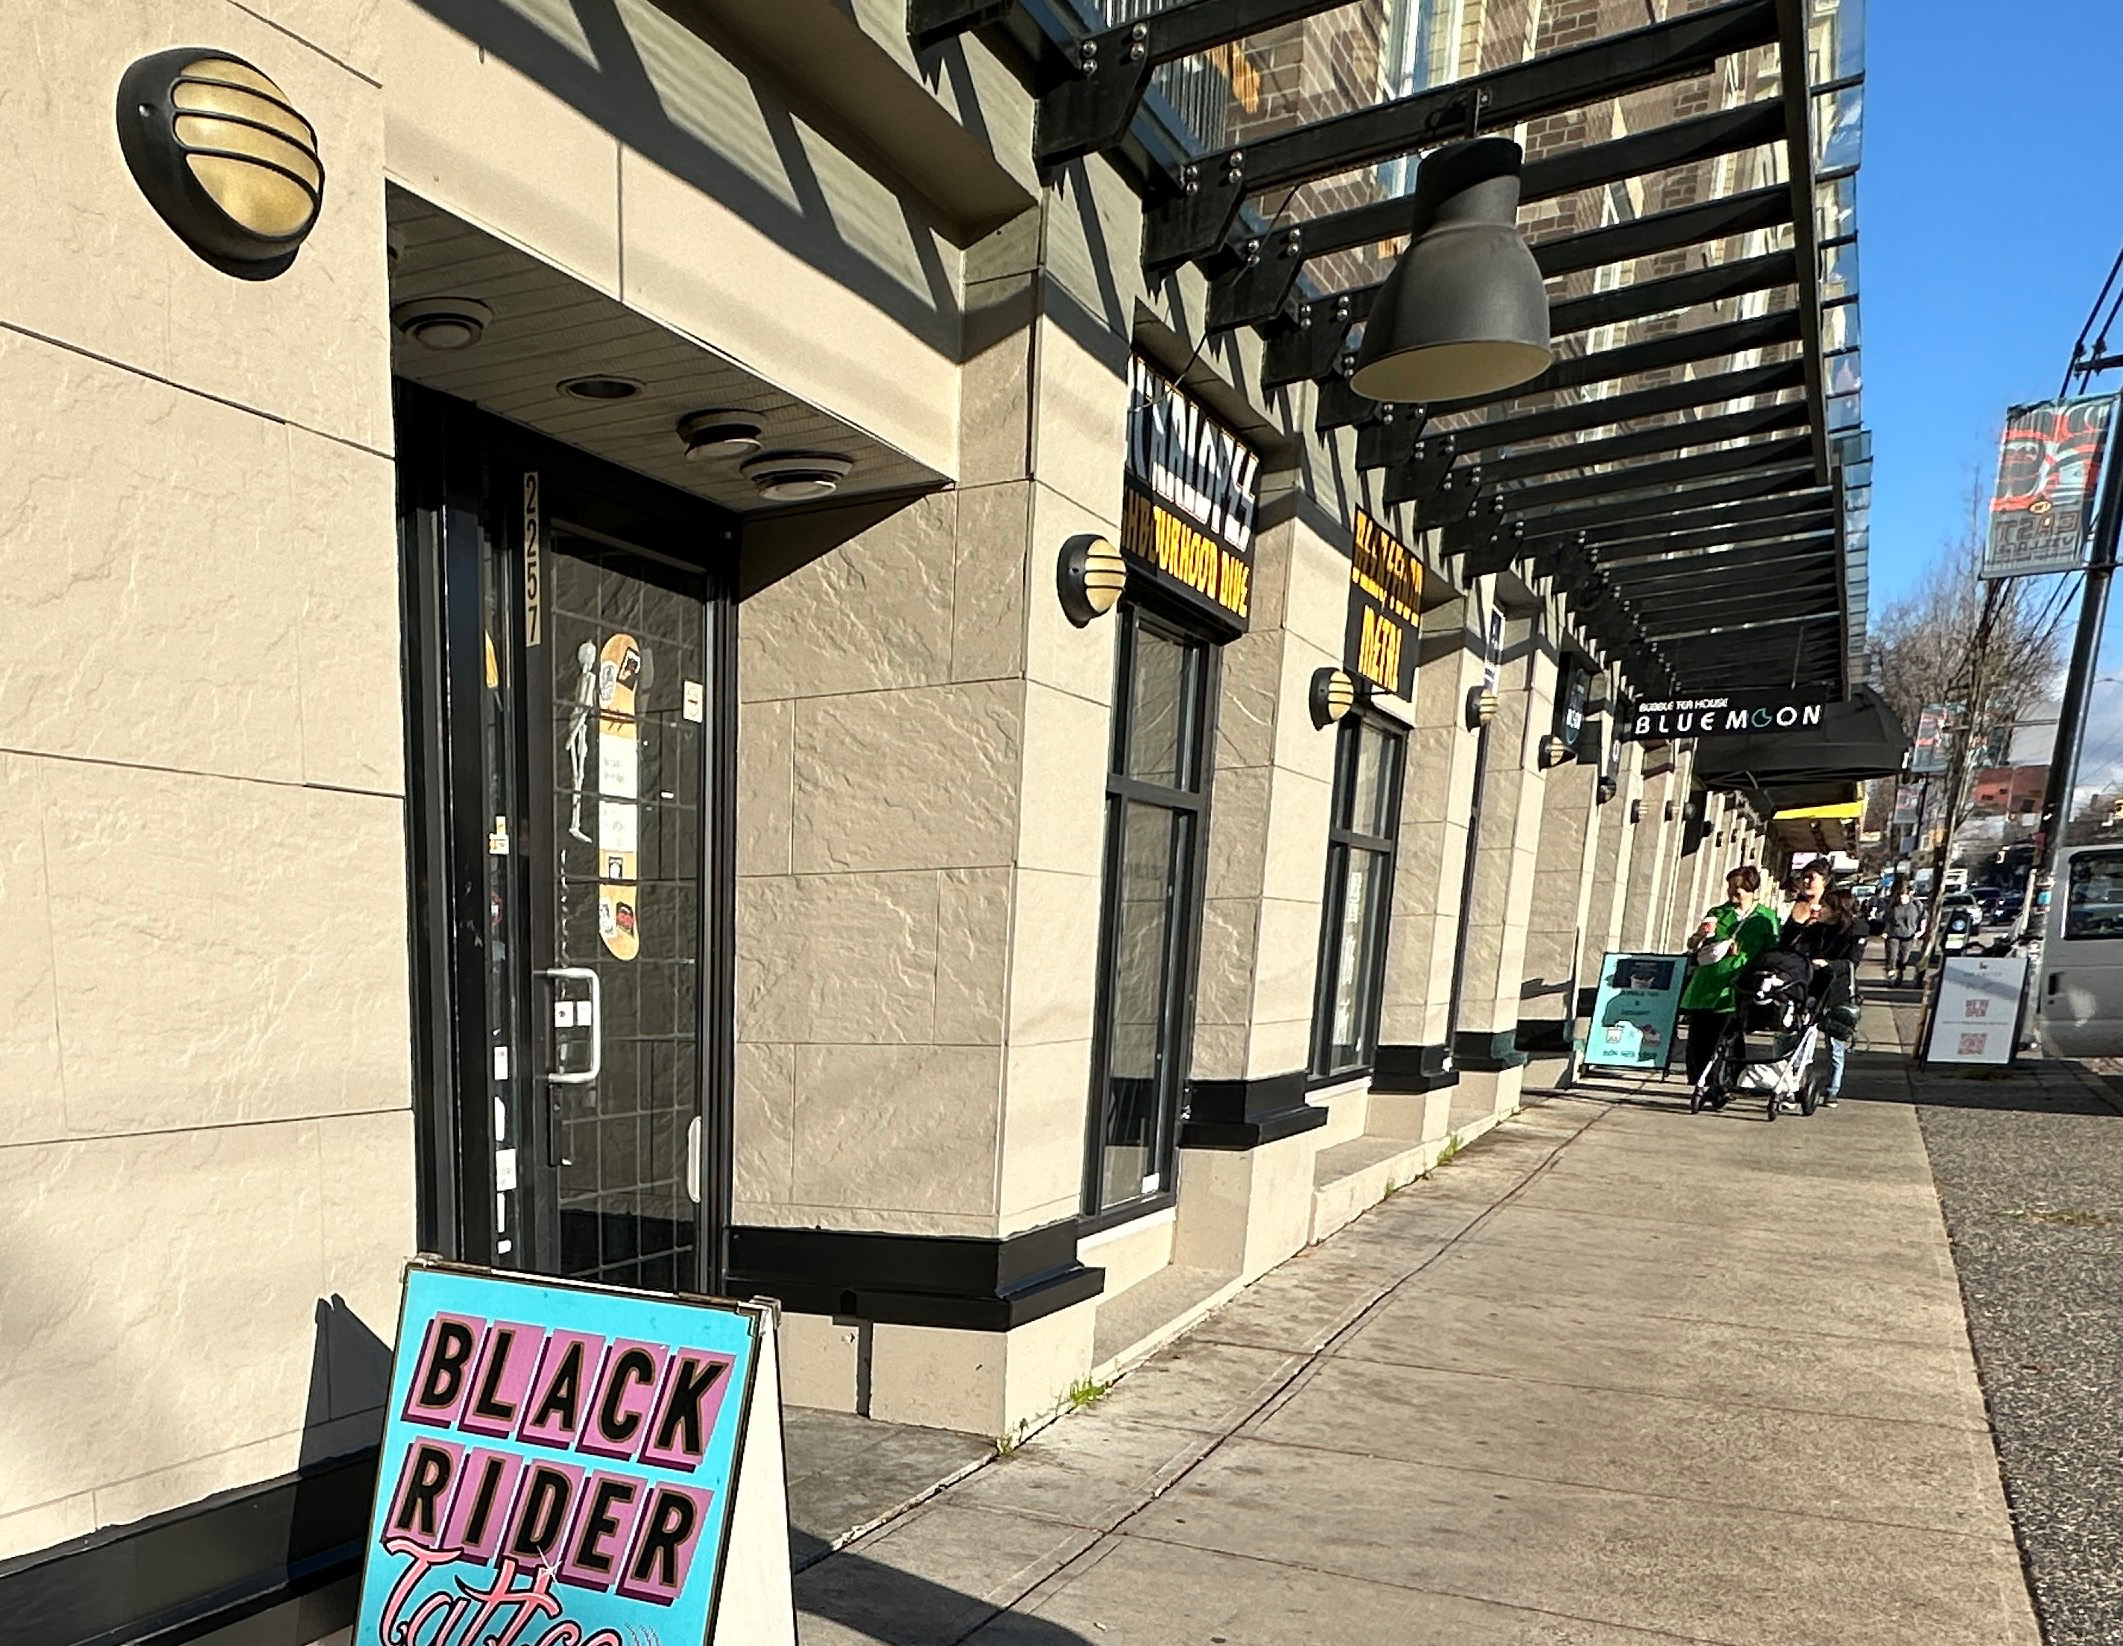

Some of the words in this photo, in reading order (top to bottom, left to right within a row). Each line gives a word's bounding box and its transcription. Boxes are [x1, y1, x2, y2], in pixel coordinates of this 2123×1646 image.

[525, 474, 538, 643] 2257
[1219, 549, 1249, 618] DIVE
[1635, 711, 1716, 735] BLUE
[416, 1320, 729, 1456] BLACK
[394, 1443, 696, 1587] RIDER
